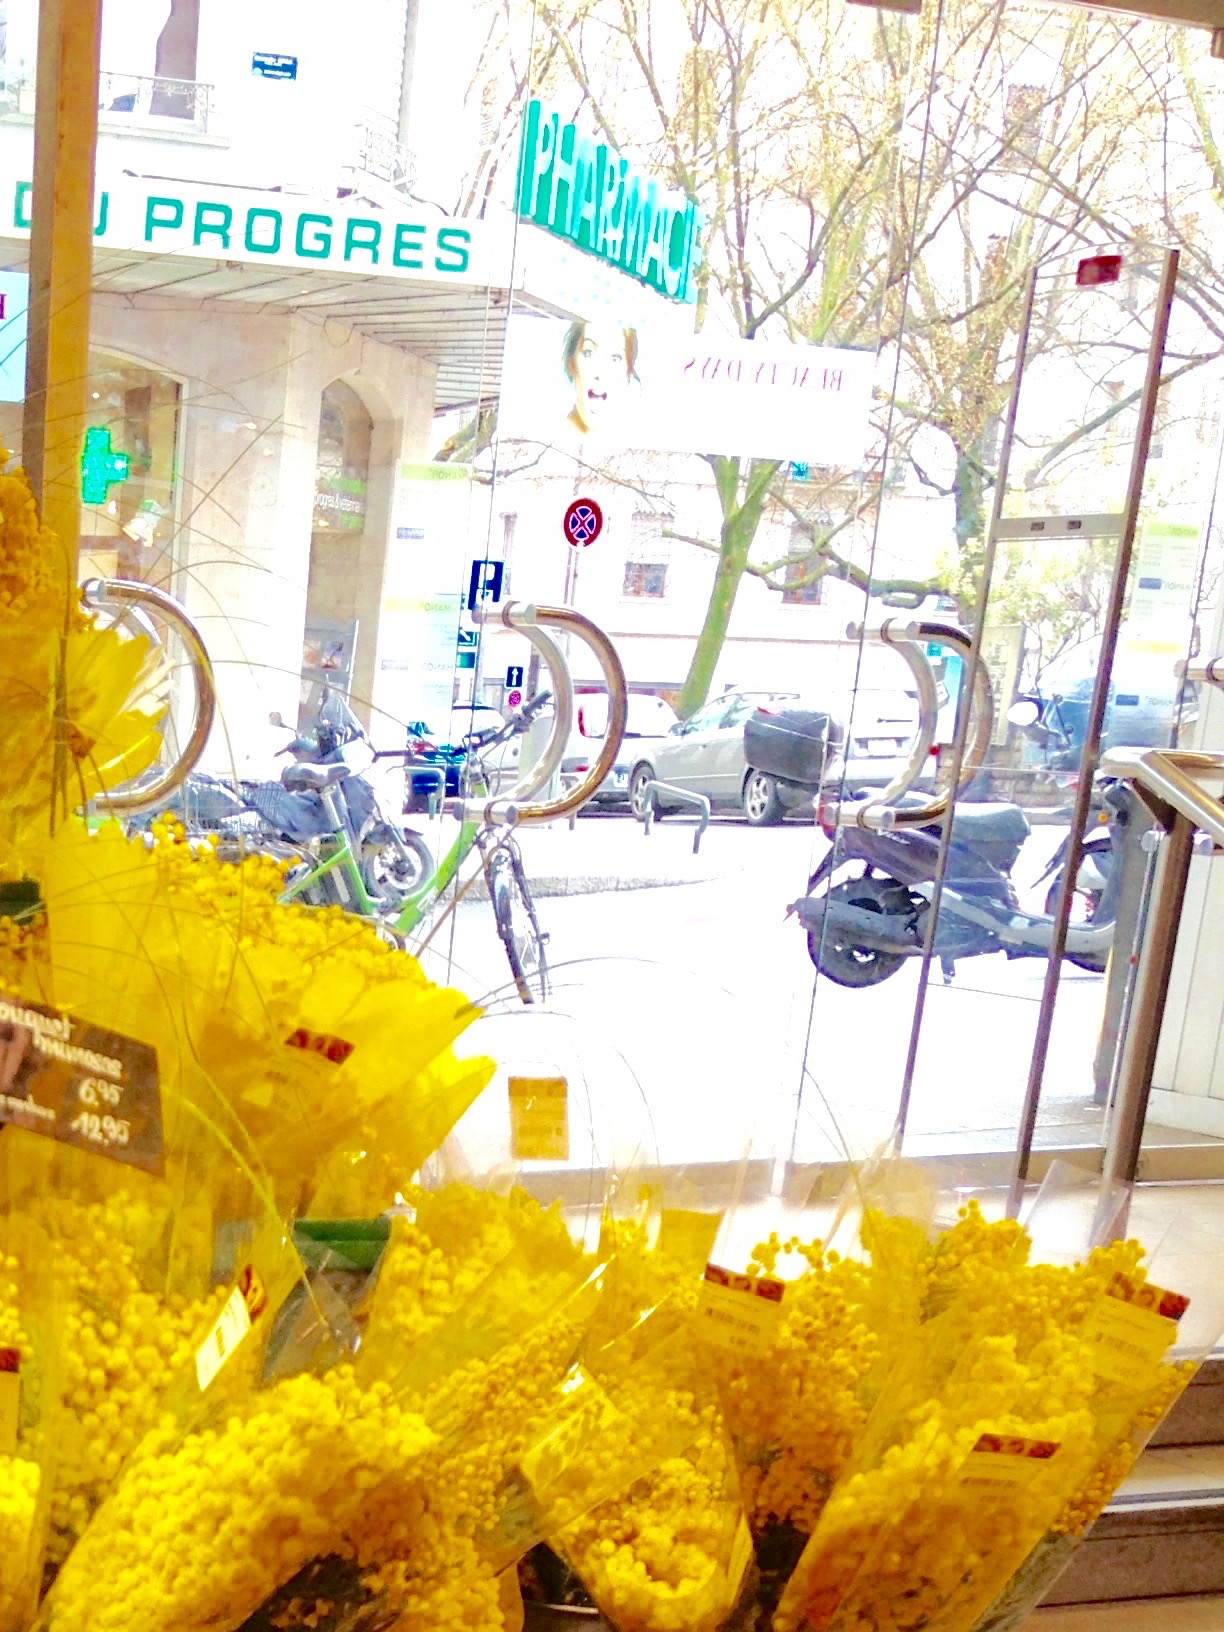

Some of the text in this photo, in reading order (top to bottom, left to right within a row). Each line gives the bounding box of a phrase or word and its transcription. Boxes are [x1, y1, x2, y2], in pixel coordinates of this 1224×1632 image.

[527, 98, 703, 302] PHARMACIE
[144, 196, 472, 273] PROGRES
[78, 1076, 124, 1107] 6.95
[71, 1110, 131, 1147] 12.95
